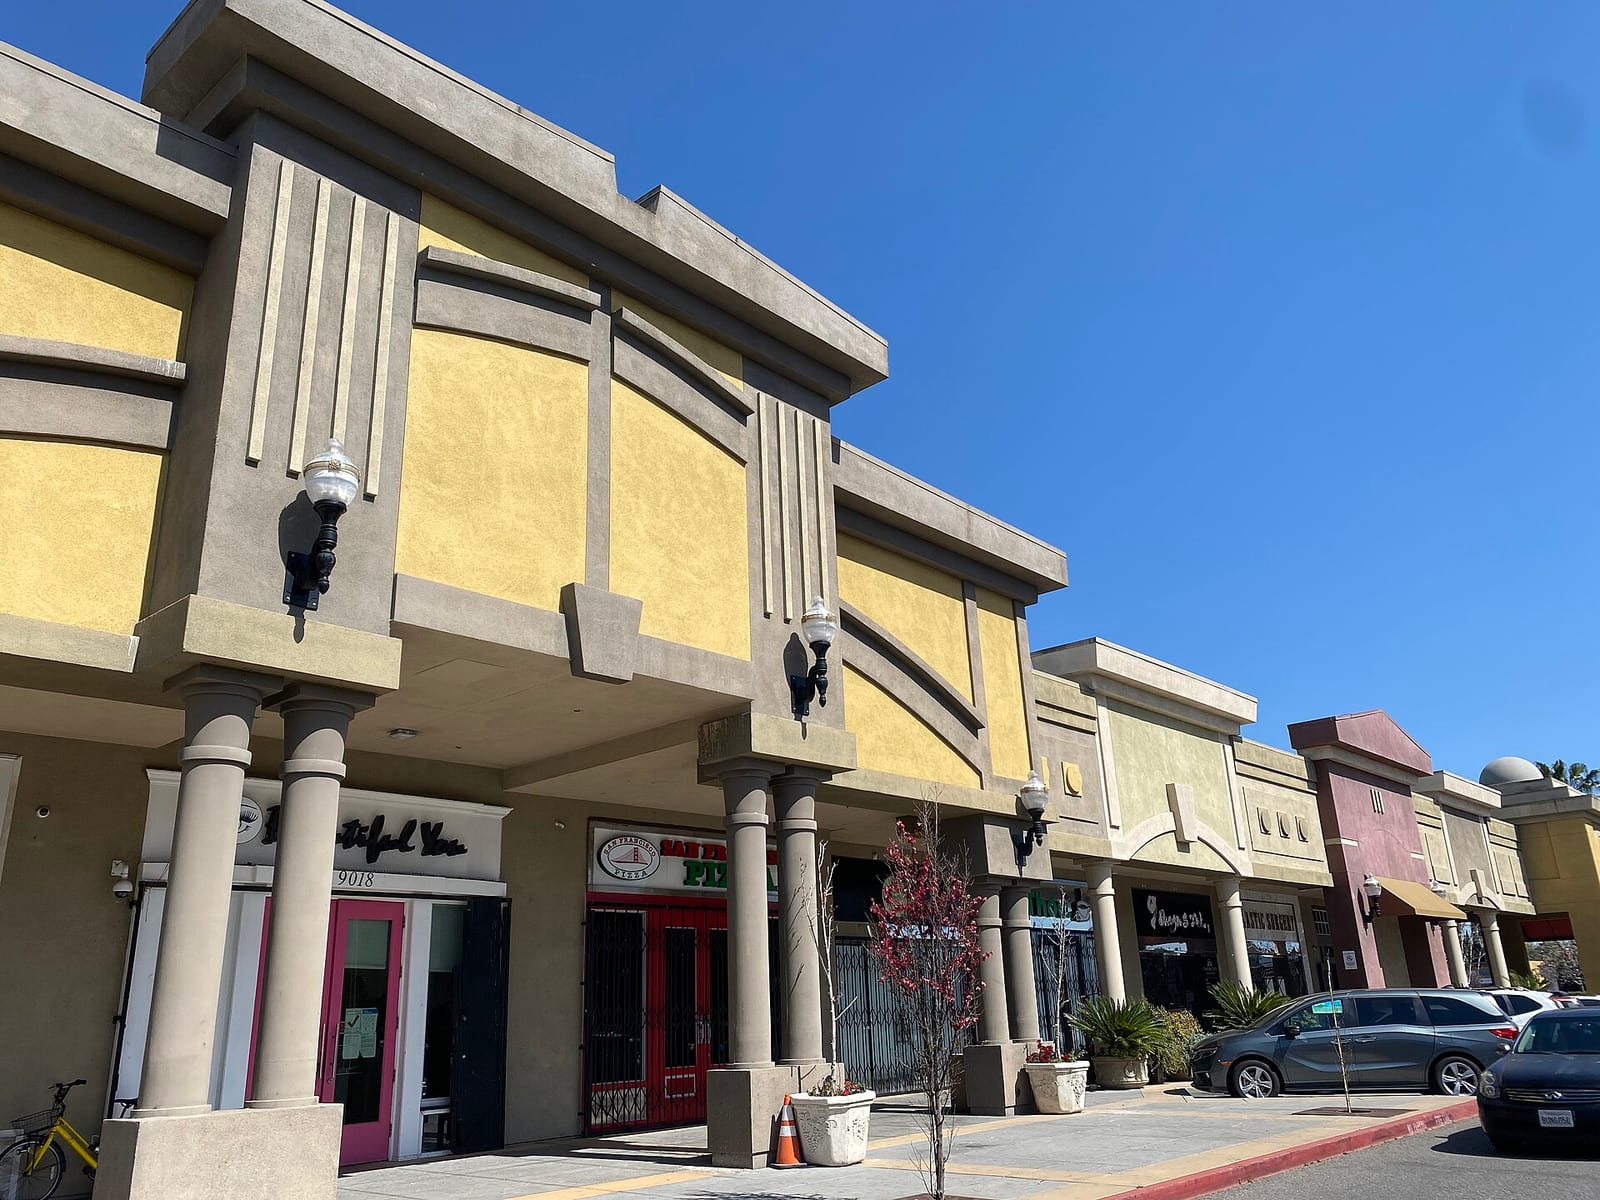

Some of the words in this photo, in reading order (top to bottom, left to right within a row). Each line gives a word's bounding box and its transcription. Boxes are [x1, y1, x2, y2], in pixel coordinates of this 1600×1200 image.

[420, 821, 468, 857] You
[603, 840, 617, 855] SAN
[619, 837, 656, 857] FRANCISCO
[660, 839, 699, 859] SAN
[338, 870, 375, 888] 9018
[614, 869, 648, 879] PIZZA
